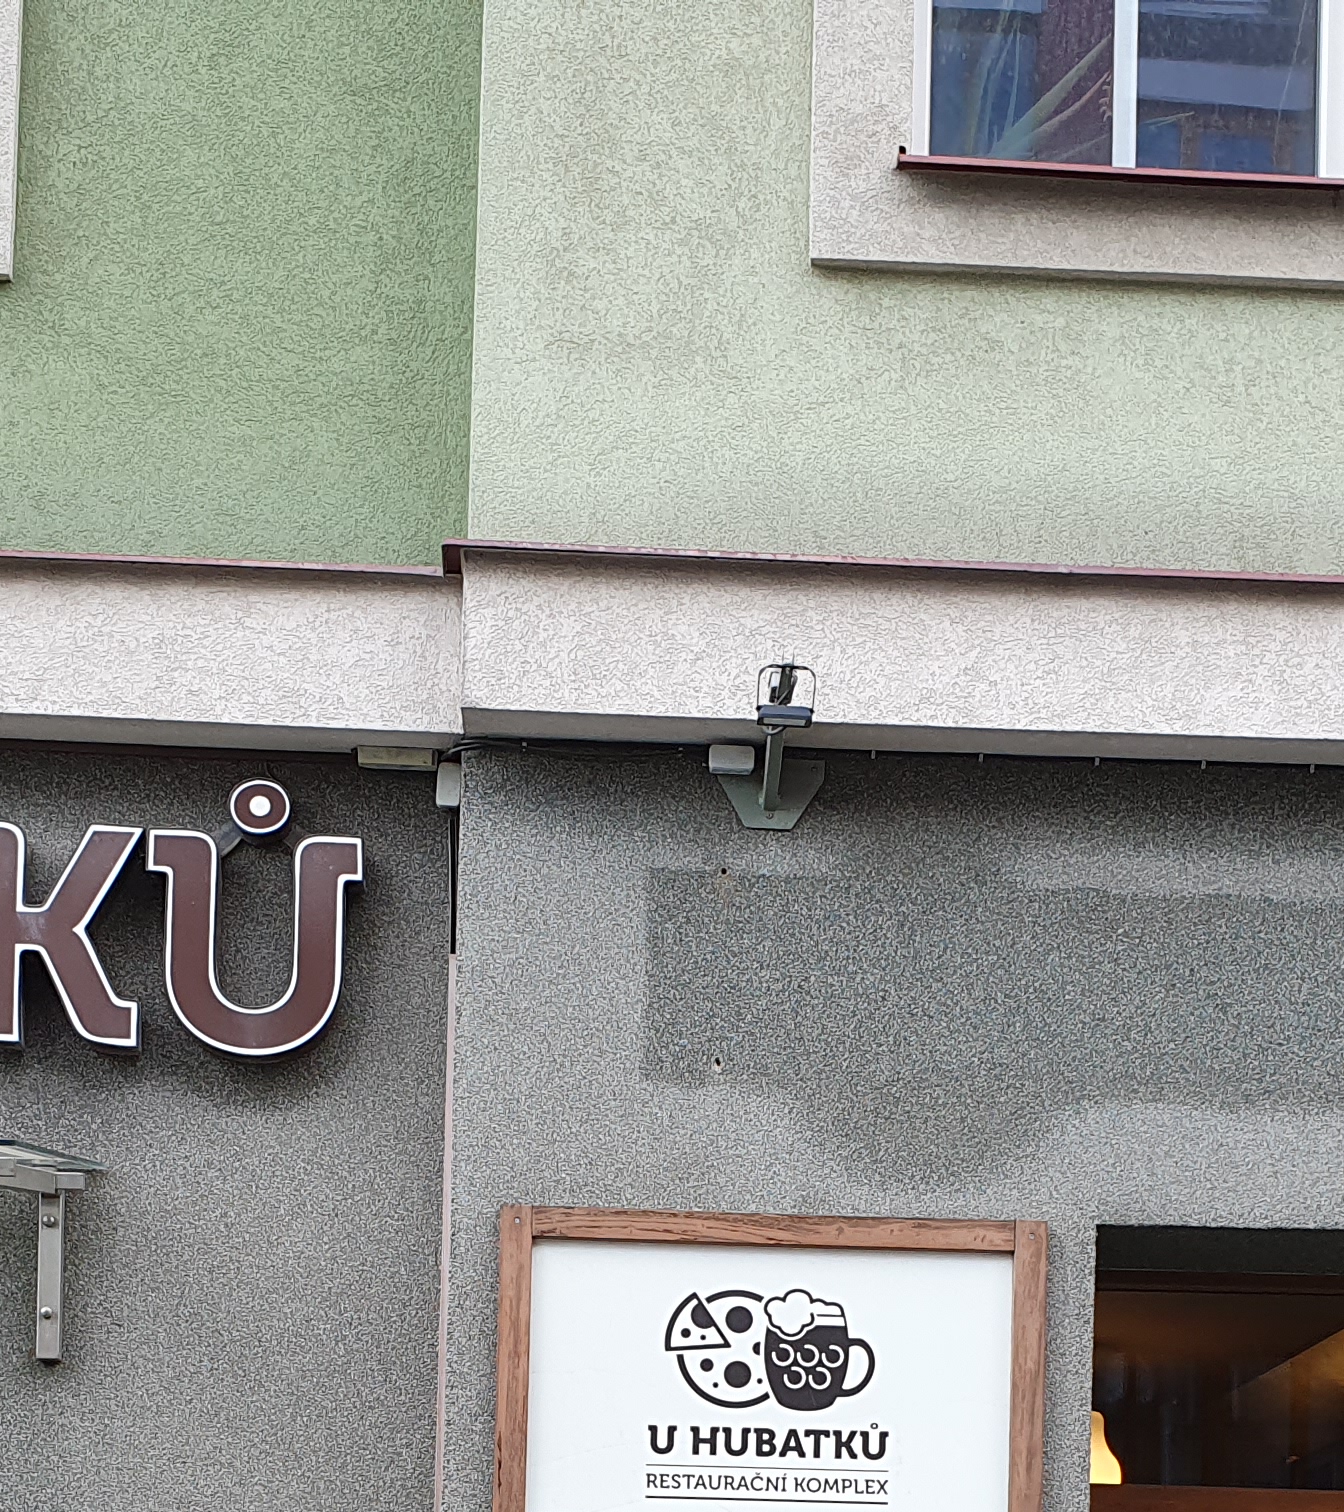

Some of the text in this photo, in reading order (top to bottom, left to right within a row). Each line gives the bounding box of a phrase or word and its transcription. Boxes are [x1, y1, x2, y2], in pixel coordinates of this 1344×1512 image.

[647, 1422, 890, 1461] U HUBATKŮ
[645, 1471, 889, 1496] RESTAURAČNÍ KOMPLEX
